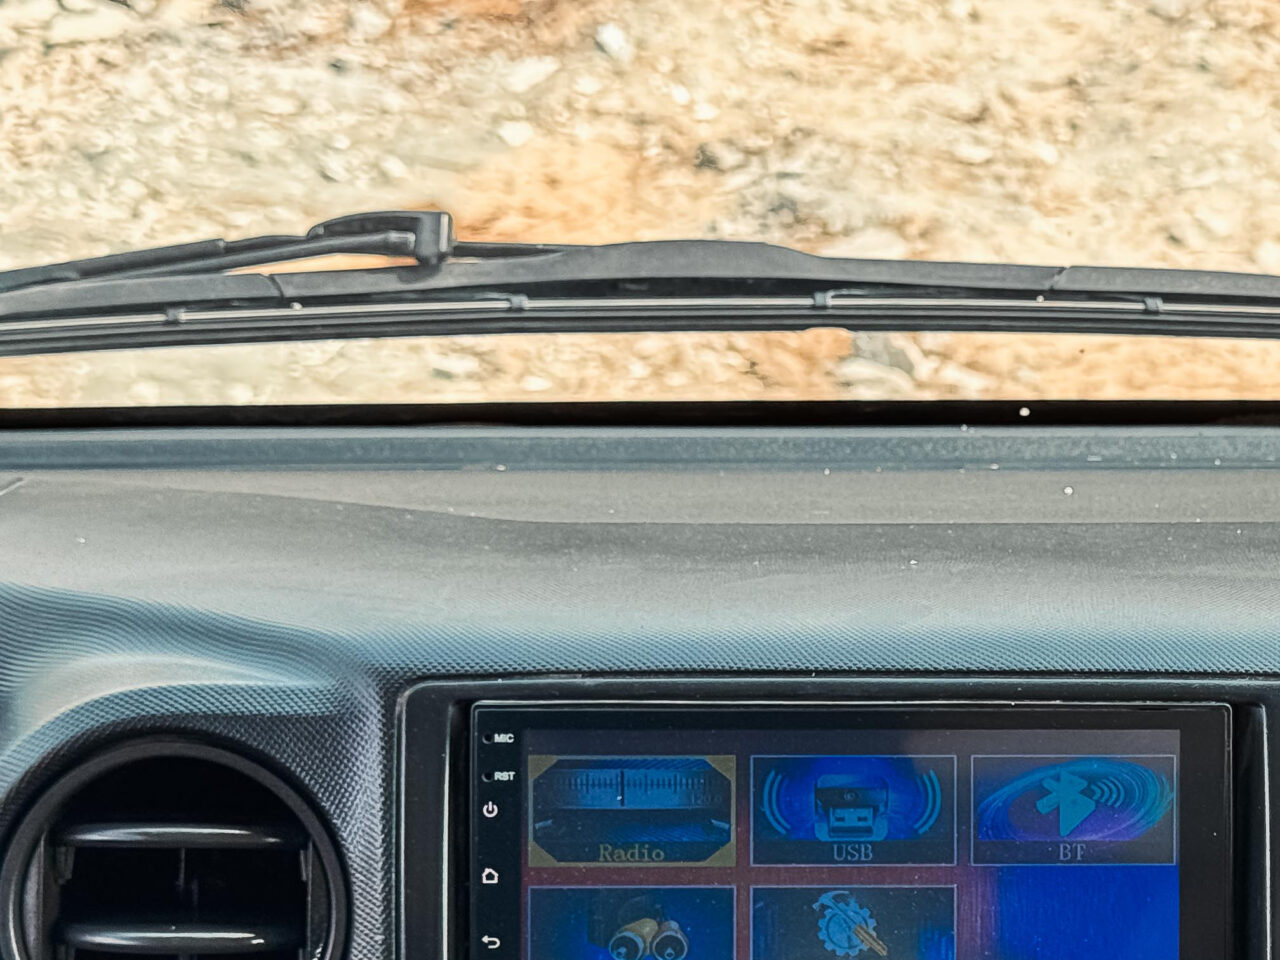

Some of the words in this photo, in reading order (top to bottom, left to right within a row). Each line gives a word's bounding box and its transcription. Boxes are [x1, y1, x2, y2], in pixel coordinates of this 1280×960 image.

[494, 733, 515, 743] MIC
[494, 771, 516, 781] RST
[599, 844, 665, 861] Radio
[833, 843, 873, 861] USB
[1059, 843, 1086, 860] BT
